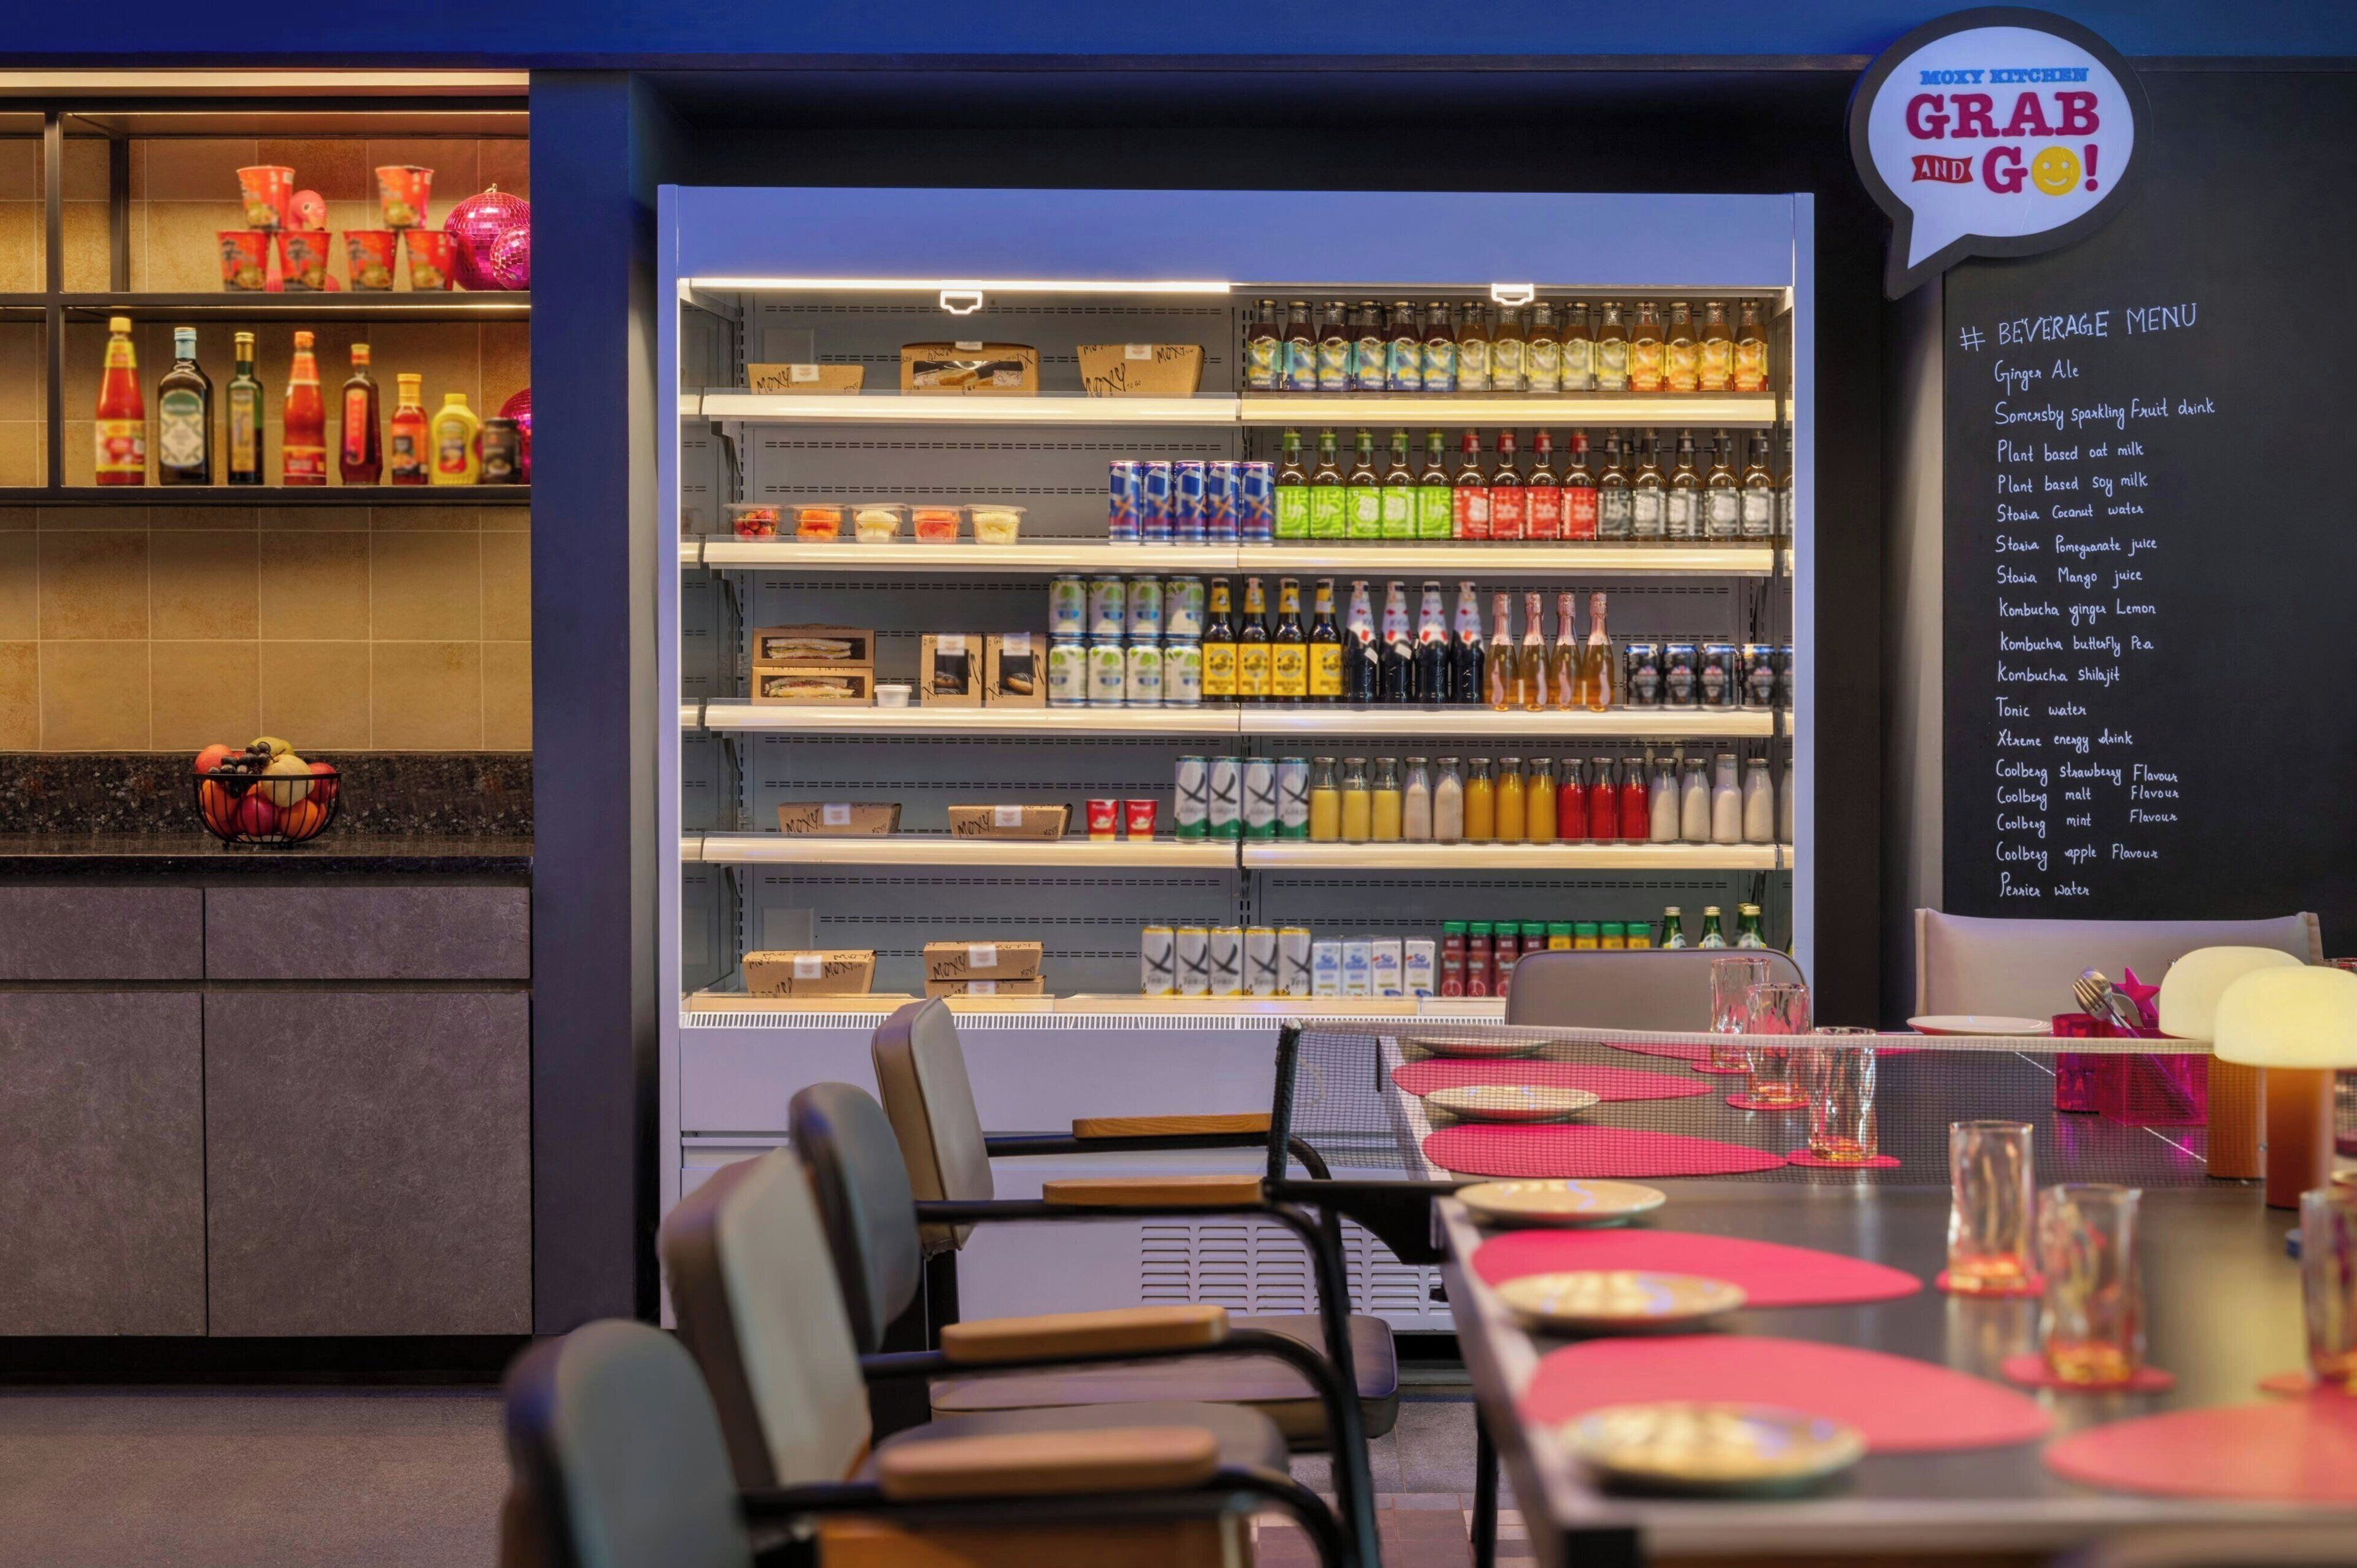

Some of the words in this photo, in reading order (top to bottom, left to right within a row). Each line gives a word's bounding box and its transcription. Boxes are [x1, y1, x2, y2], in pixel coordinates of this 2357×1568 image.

[1920, 69, 1984, 85] MOXY
[1990, 68, 2089, 83] KITCHEN
[1906, 91, 2100, 140] GRAB
[1920, 158, 1965, 181] AND
[1999, 310, 2110, 345] BEVERAGE
[2126, 303, 2197, 334] MENU
[1156, 346, 1185, 363] MOXY
[1994, 359, 2042, 396] Ginger
[2051, 358, 2080, 379] Ale
[1995, 401, 2064, 431] Somersby
[2070, 403, 2125, 430] sparkling
[2131, 397, 2169, 419] Fruit
[2178, 397, 2215, 415] drink
[1997, 439, 2034, 463] Plant
[2044, 442, 2078, 462] based
[2089, 442, 2108, 458] oat
[2118, 441, 2144, 456] milk
[1998, 474, 2033, 494] Plant
[2045, 474, 2079, 492] based
[2092, 476, 2113, 498] soy
[2121, 471, 2148, 487] milk
[2108, 501, 2144, 516] water
[2055, 534, 2121, 560] Pomegranate
[2127, 538, 2158, 557] juice
[2057, 566, 2097, 589] Mango
[2112, 570, 2143, 589] juice
[1999, 597, 2060, 617] Kombucha
[2069, 603, 2107, 627] ginger
[2116, 598, 2156, 615] Lemon
[2000, 630, 2064, 652] Kombucha
[2131, 635, 2154, 650] Pea
[1997, 660, 2069, 682] Kombucha
[1995, 696, 2030, 717] Tonic
[2048, 701, 2087, 716] water
[2053, 735, 2089, 754] energy
[2097, 728, 2134, 745] drink
[1995, 758, 2048, 788] Coolberg
[2059, 762, 2122, 786] strawberry
[2133, 763, 2178, 782] Flavour
[1997, 785, 2048, 811] Coolberg
[2065, 786, 2091, 801] malt
[2131, 784, 2180, 800] Flavour
[785, 808, 820, 834] MOXY
[958, 809, 991, 838] MOXY
[1996, 813, 2046, 839] Coolberg
[2066, 813, 2091, 827] mint
[2129, 808, 2178, 824] Flavour
[1995, 841, 2048, 871] Coolberg
[2064, 844, 2097, 865] apple
[2112, 843, 2159, 860] Flavour
[1999, 871, 2041, 897] Perrier
[2054, 881, 2090, 896] water
[824, 962, 854, 978] MOXY
[932, 955, 967, 980] MOXY
